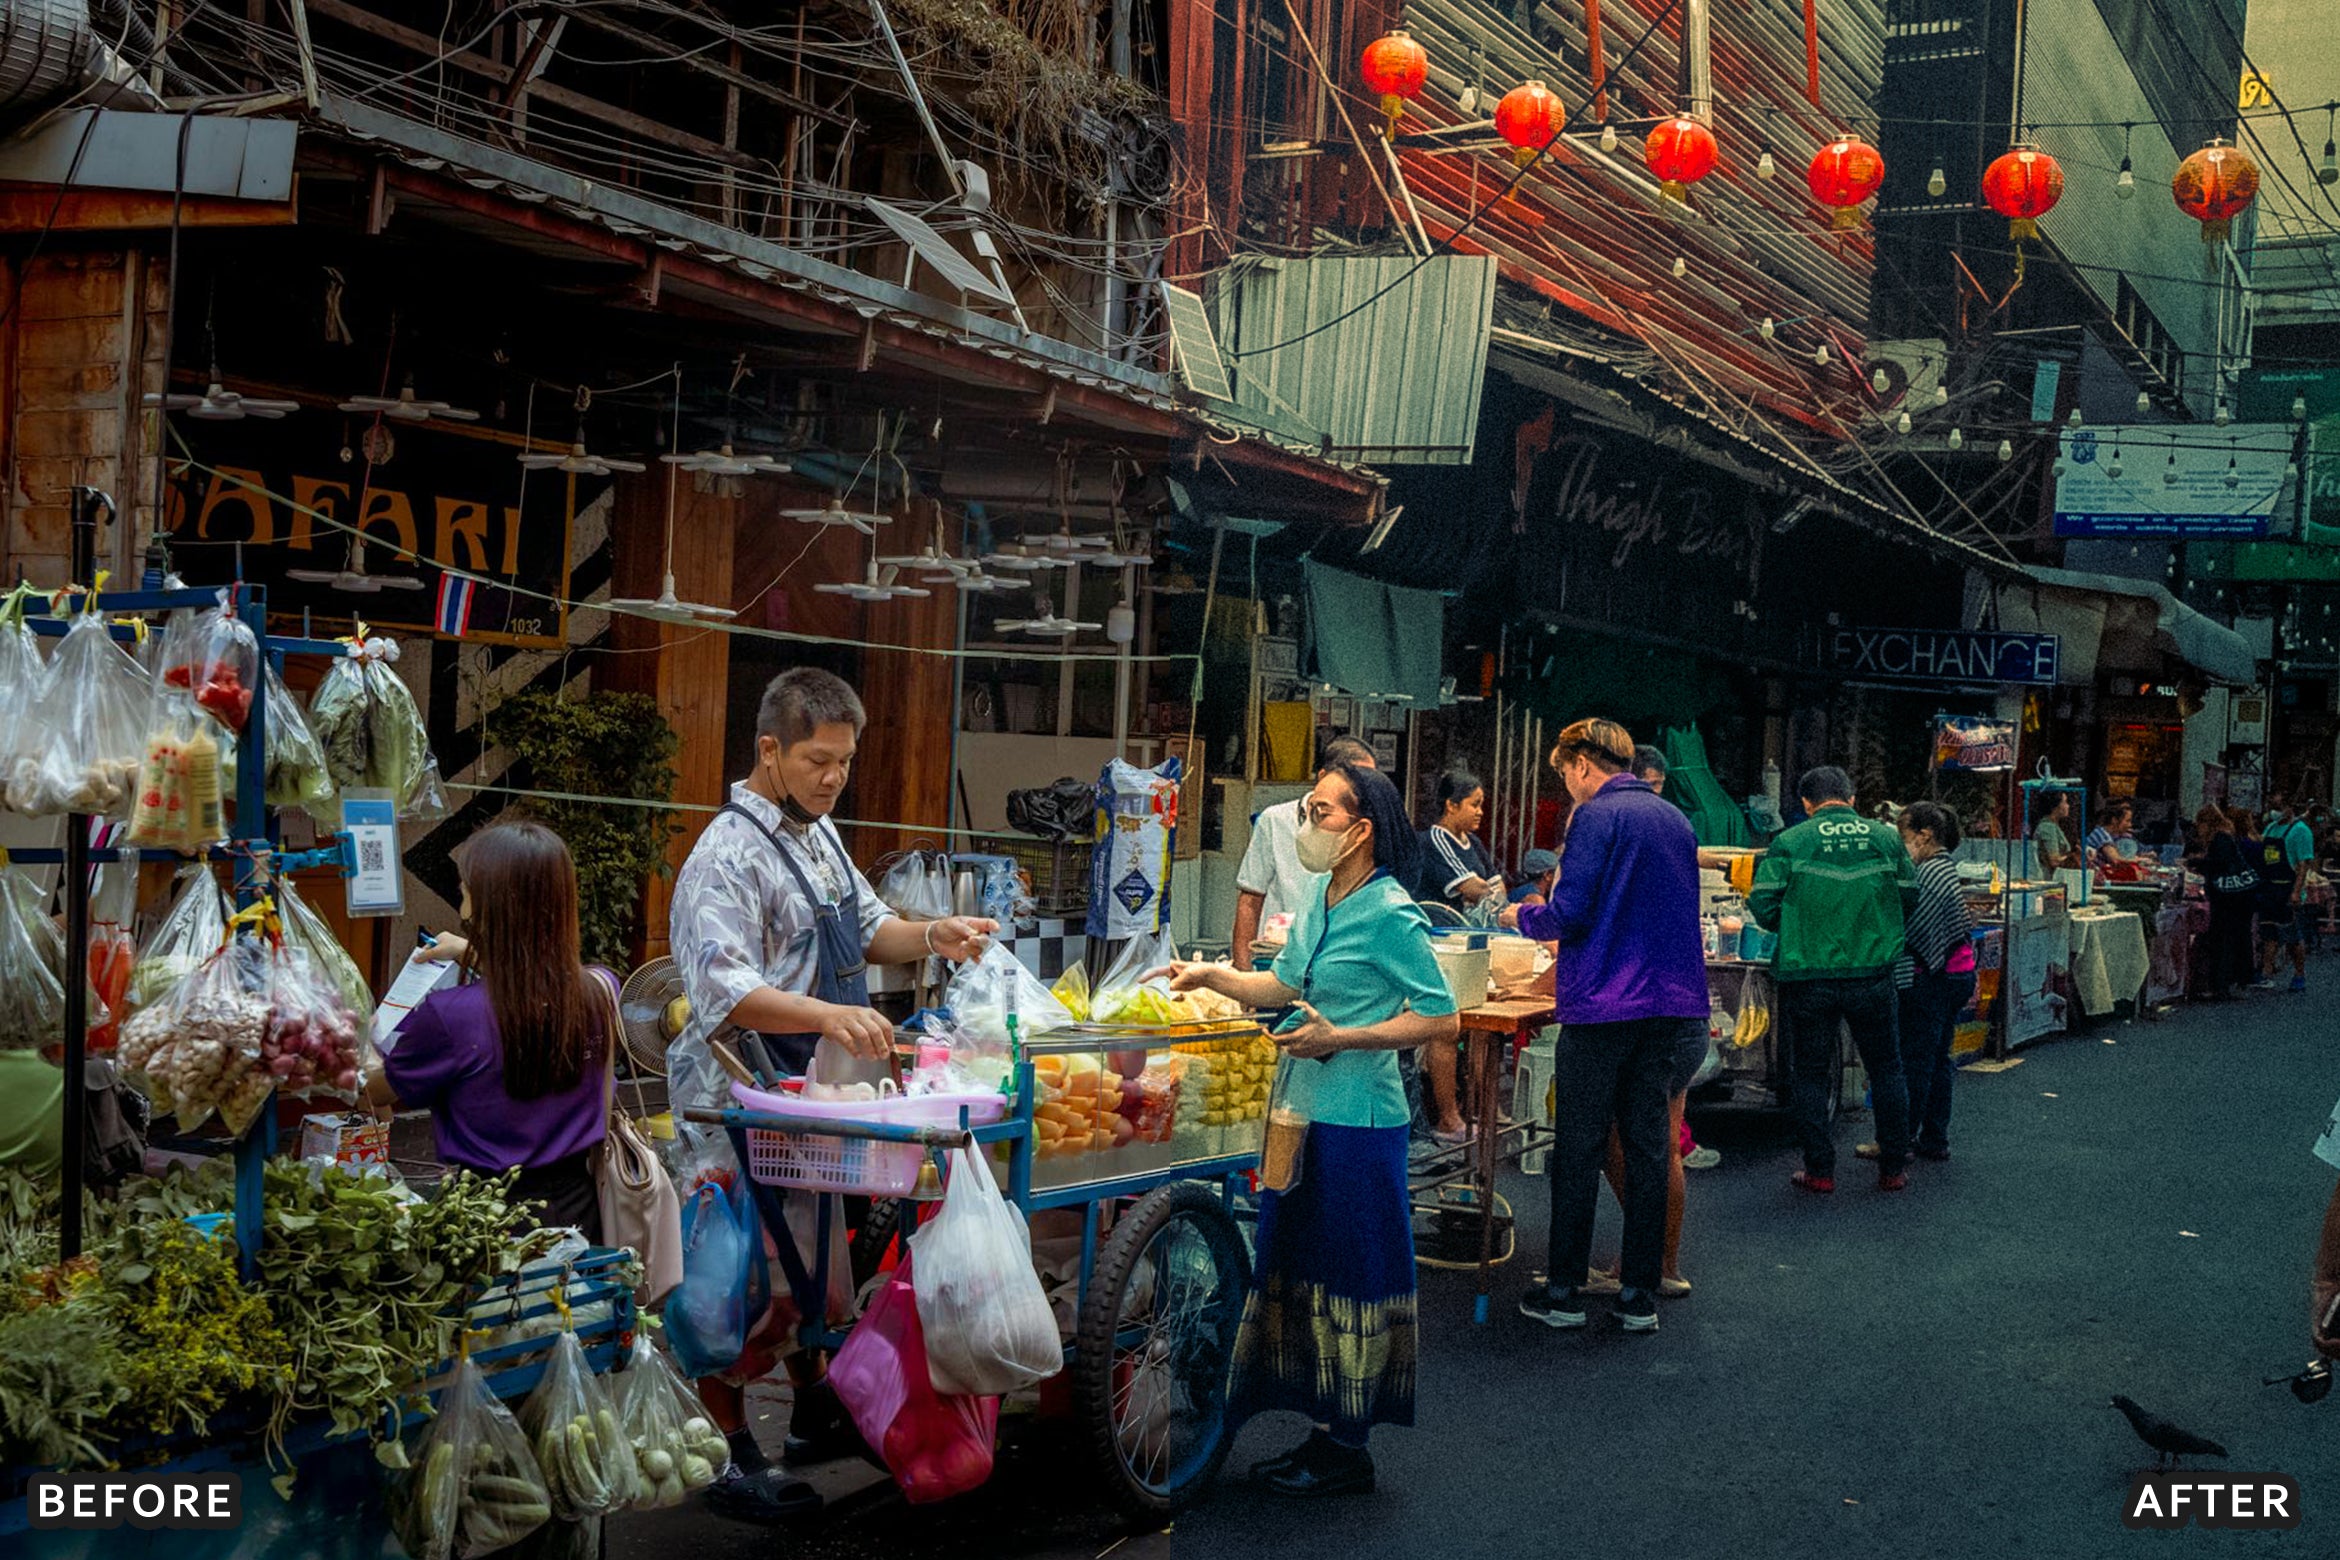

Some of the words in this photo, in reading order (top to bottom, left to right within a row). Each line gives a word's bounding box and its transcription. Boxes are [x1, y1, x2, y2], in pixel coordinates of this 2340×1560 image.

[1553, 433, 1668, 568] Thigh
[510, 617, 542, 636] 1032
[1834, 631, 2055, 681] EXCHANGE
[1818, 820, 1870, 836] Grab
